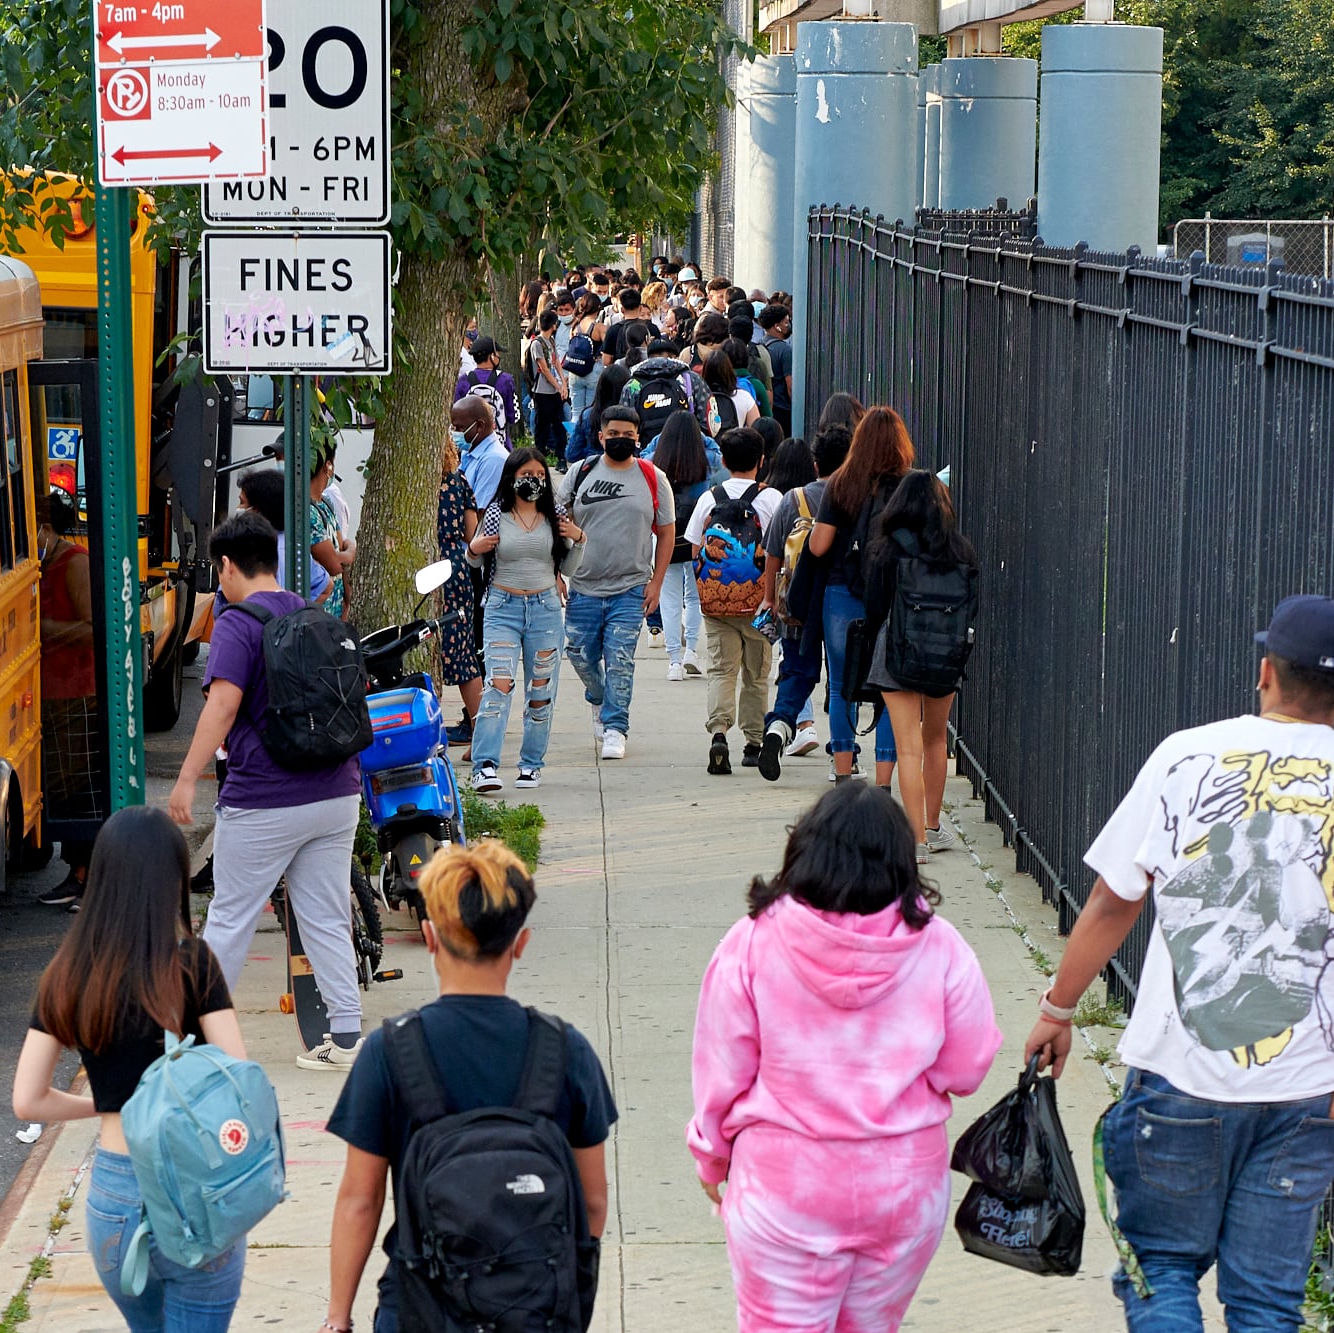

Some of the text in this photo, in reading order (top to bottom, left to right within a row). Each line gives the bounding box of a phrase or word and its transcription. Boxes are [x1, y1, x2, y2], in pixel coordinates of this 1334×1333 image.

[105, 4, 137, 22] 7am
[151, 2, 184, 24] 4pm
[157, 72, 206, 89] Monday
[158, 95, 205, 111] 8:30am
[219, 94, 251, 108] 10am
[313, 136, 375, 161] 6PM
[223, 176, 287, 201] MON
[324, 176, 368, 201] FRI
[240, 258, 353, 291] FINES
[225, 314, 370, 347] HIGHER
[589, 480, 625, 496] NIKE
[979, 1222, 1031, 1248] Here!
